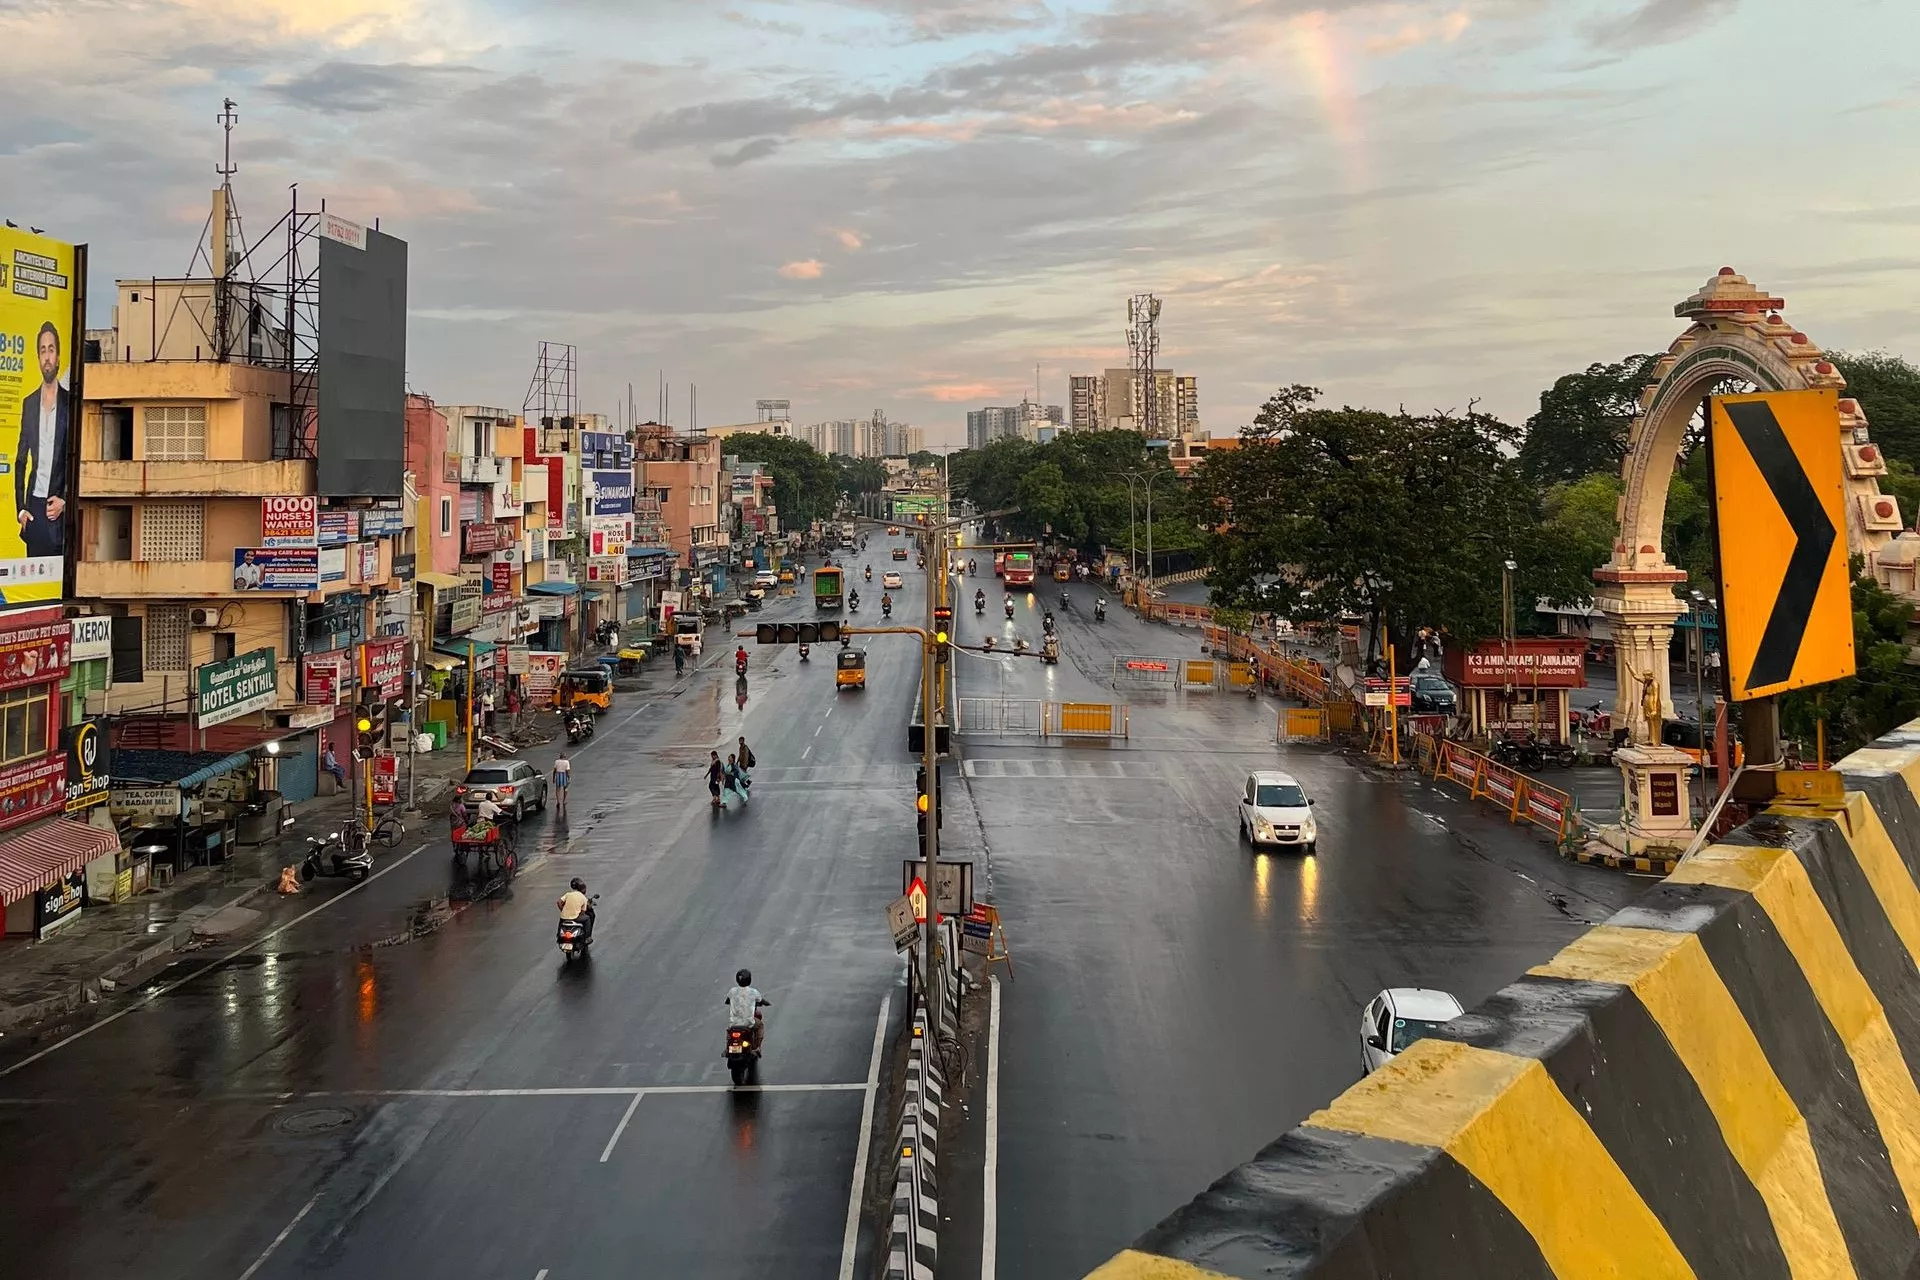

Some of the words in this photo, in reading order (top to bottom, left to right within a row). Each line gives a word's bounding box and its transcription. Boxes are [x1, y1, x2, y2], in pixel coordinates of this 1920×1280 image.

[15, 251, 56, 271] ARCHITECTURE
[0, 356, 23, 372] 2024
[264, 498, 312, 512] 1000
[266, 512, 311, 520] NURSE'S
[264, 520, 312, 528] WANTED
[614, 546, 624, 554] 40
[18, 629, 40, 642] EXOTIC
[40, 626, 52, 638] PET
[52, 624, 70, 636] STORE
[202, 685, 234, 712] HOTEL
[236, 672, 274, 700] SENTHIL
